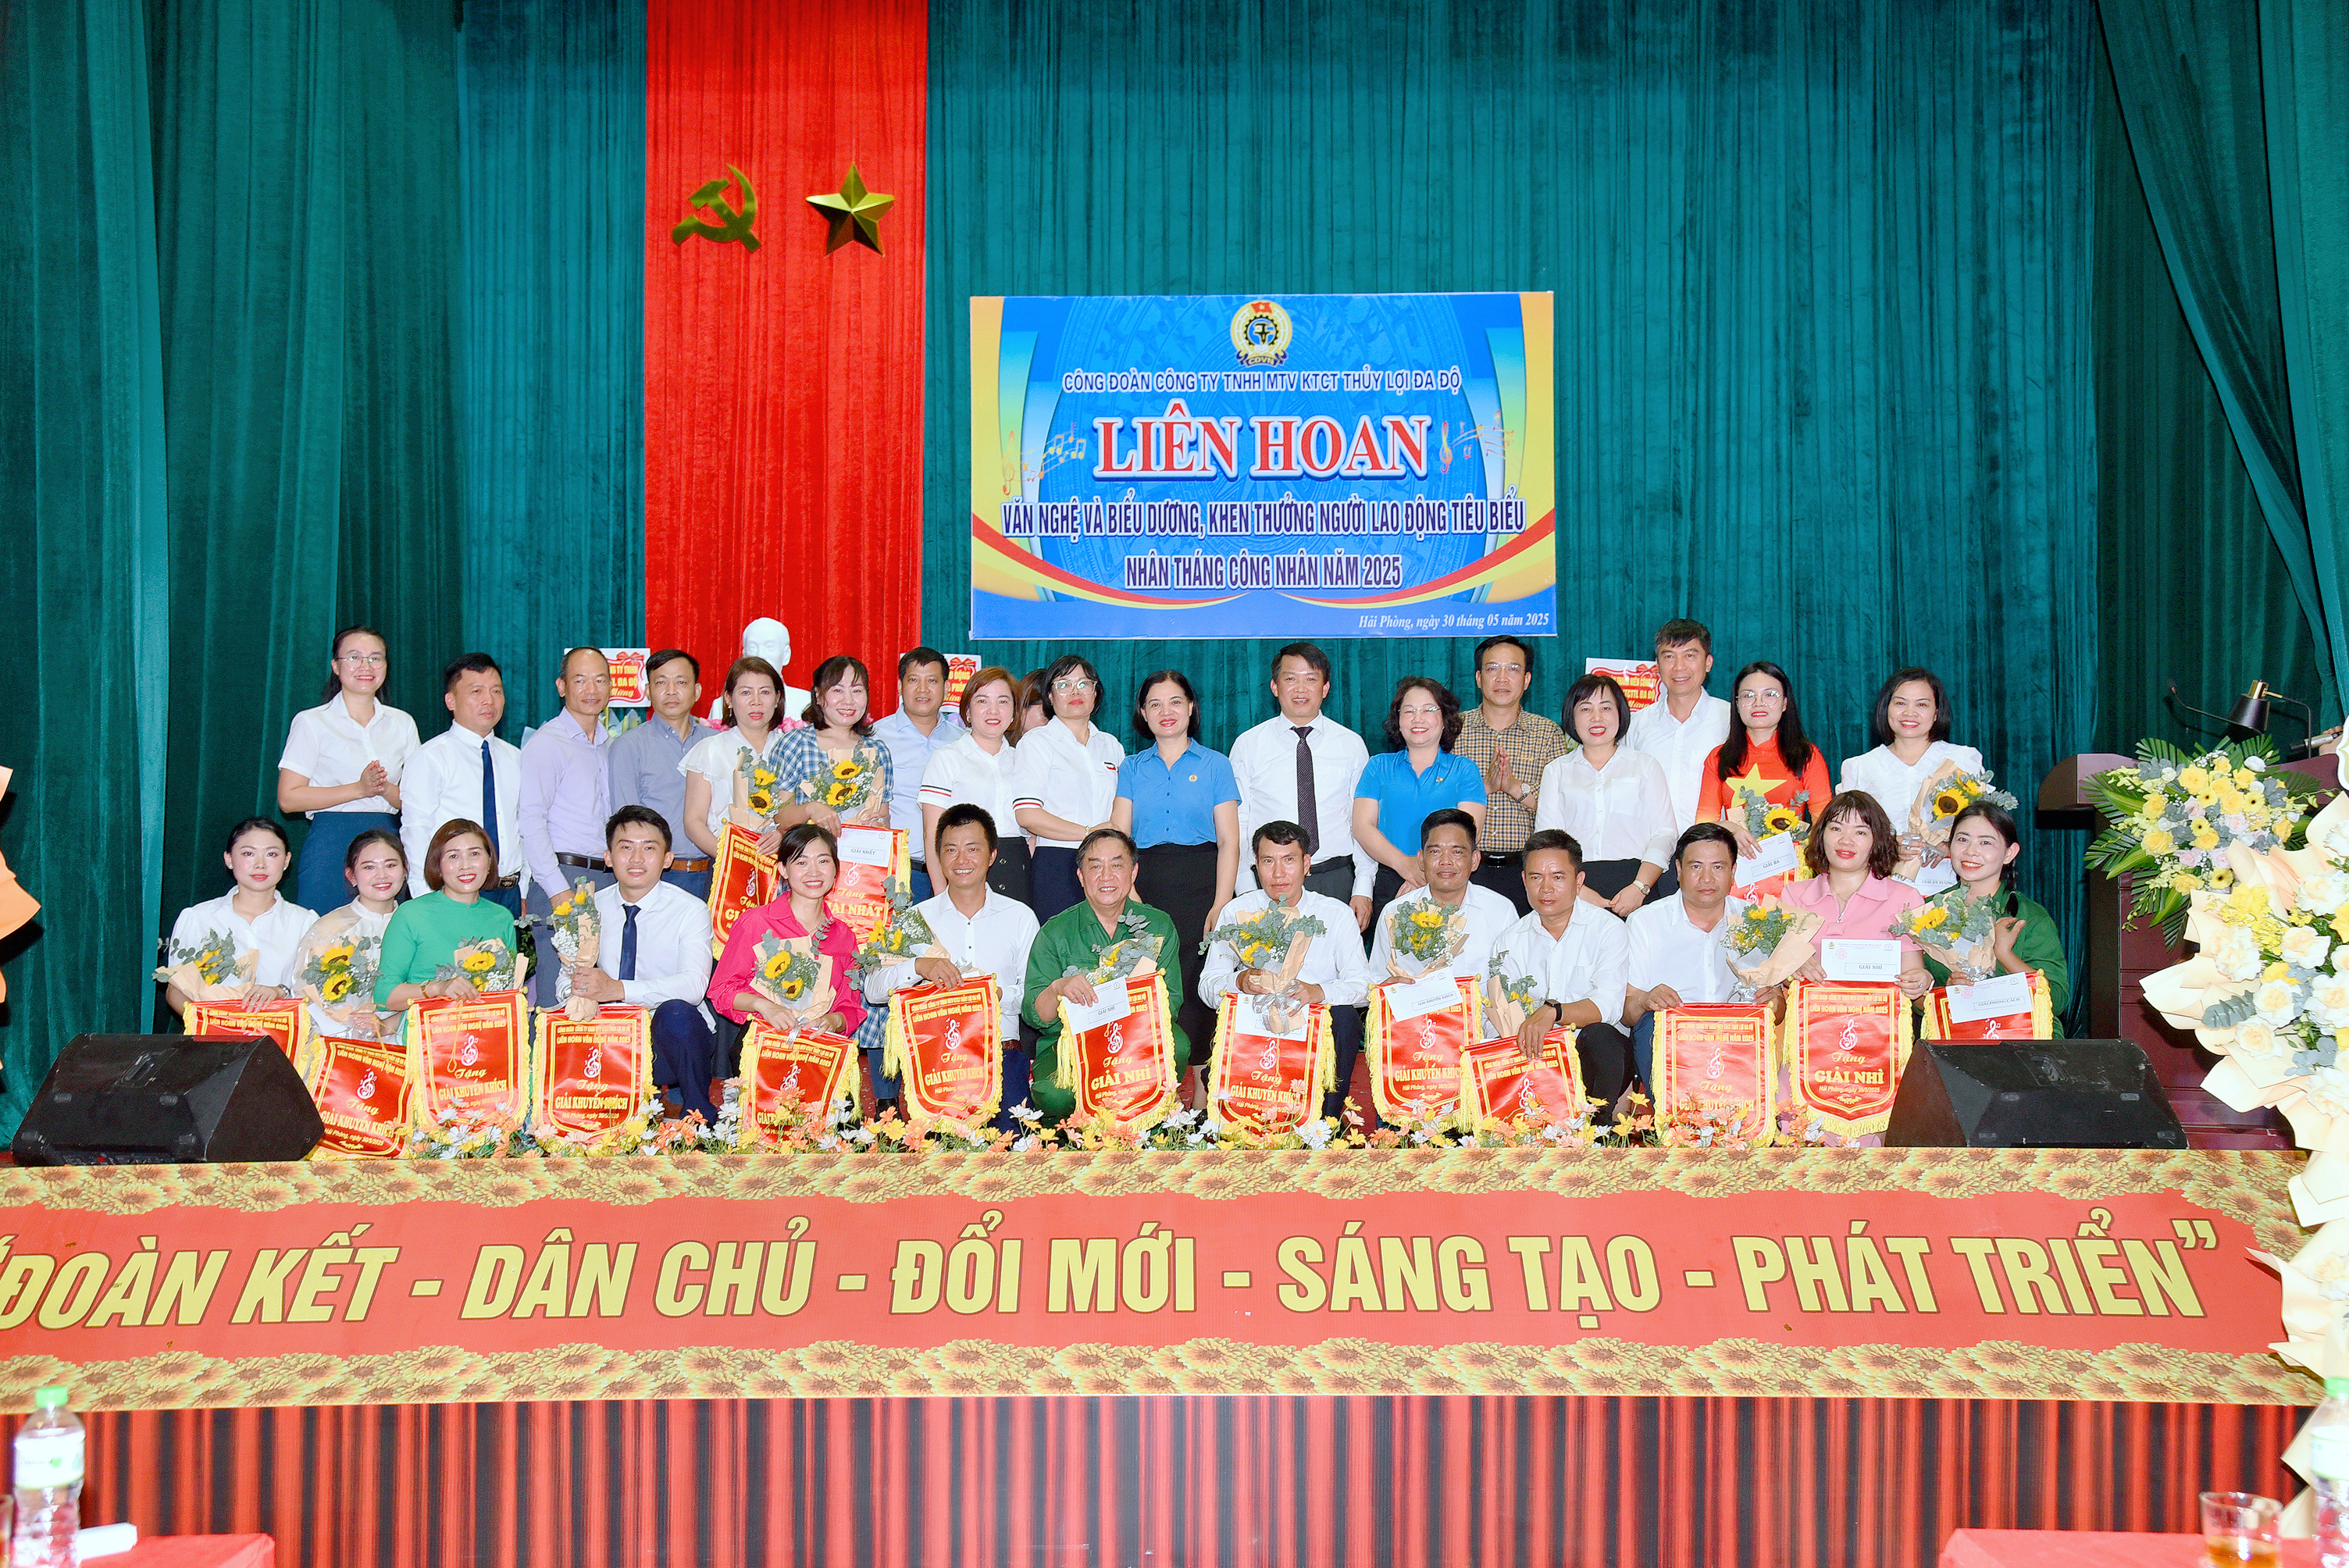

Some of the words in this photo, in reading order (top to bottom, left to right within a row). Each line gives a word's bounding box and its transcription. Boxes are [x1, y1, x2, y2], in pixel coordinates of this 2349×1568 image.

[1064, 369, 1103, 390] CÔNG
[1109, 369, 1150, 390] ĐOÀN
[1156, 369, 1195, 390] CÔNG
[1200, 372, 1220, 390] TY
[1224, 372, 1260, 390] TNHH
[1267, 372, 1298, 390] MTV
[1303, 372, 1338, 390] KTCT
[1344, 365, 1385, 390] THỦY
[1388, 371, 1410, 394] LỢI
[1413, 372, 1434, 390] ĐA
[1440, 367, 1460, 394] ĐỘ
[1095, 401, 1240, 475] LIÊN
[1251, 418, 1431, 475] HOAN
[1003, 497, 1034, 534] VĂN
[1039, 497, 1080, 541] NGHỆ
[1084, 497, 1104, 533] VÀ
[1108, 488, 1142, 533] BIỂU
[1147, 501, 1205, 538] DƯƠNG,
[1209, 502, 1250, 533] KHEN
[1254, 493, 1315, 533] THƯỞNG
[1320, 494, 1367, 533] NGƯỜI
[1371, 501, 1399, 533] LAO
[1405, 494, 1446, 540] ĐỘNG
[1451, 494, 1484, 532] TIÊU
[1489, 486, 1525, 532] BIỂU
[1126, 550, 1170, 586] NHÂN
[1174, 550, 1224, 586] THÁNG
[1228, 550, 1271, 586] CÔNG
[1276, 550, 1319, 586] NHÂN
[1324, 550, 1360, 586] NĂM
[1363, 555, 1401, 586] 2025
[1359, 615, 1377, 628] Hải
[1379, 615, 1414, 630] Phòng,
[1416, 615, 1441, 630] ngày
[1442, 614, 1455, 627] 30
[1456, 614, 1485, 629] tháng
[1486, 614, 1499, 626] 05
[1501, 614, 1523, 626] năm
[1525, 612, 1550, 625] 2025
[740, 896, 757, 908] Tặn
[848, 900, 883, 917] NHẤT
[941, 1053, 968, 1063] Tặng
[1103, 1056, 1132, 1067] Tặng
[1413, 1051, 1444, 1063] Tặng
[1831, 1052, 1866, 1064] Tặng
[454, 1068, 487, 1079] Tặng
[925, 1068, 942, 1086] GIẢI
[941, 1063, 967, 1082] KHUYẾN
[1091, 1069, 1121, 1090] GIẢI
[1123, 1064, 1152, 1083] NHÌ
[1251, 1070, 1283, 1084] Tặng
[1395, 1064, 1410, 1082] GIẢI
[1410, 1063, 1441, 1081] KHUYẾN
[1814, 1066, 1850, 1083] GIẢI
[1854, 1068, 1884, 1084] NHÌ
[454, 1078, 483, 1098] KHUYẾN
[484, 1078, 507, 1094] KHÍCH
[576, 1079, 609, 1092] Tặng
[1231, 1081, 1247, 1098] GIẢI
[1247, 1085, 1278, 1102] KHUYẾN
[347, 1099, 379, 1116] Tặng
[555, 1092, 572, 1109] GIẢI
[572, 1093, 604, 1109] KHUYẾN
[321, 1108, 338, 1125] GIẢI
[338, 1114, 371, 1132] KHUYẾN
[229, 1223, 401, 1324] KẾT
[458, 1227, 638, 1320] DÂN
[652, 1215, 818, 1318] CHỦ
[889, 1208, 1022, 1316] ĐỔI
[1046, 1221, 1198, 1315] MỚI
[1276, 1220, 1494, 1316] SÁNG
[1508, 1235, 1663, 1331] TẠO
[1731, 1220, 1940, 1316] PHÁT
